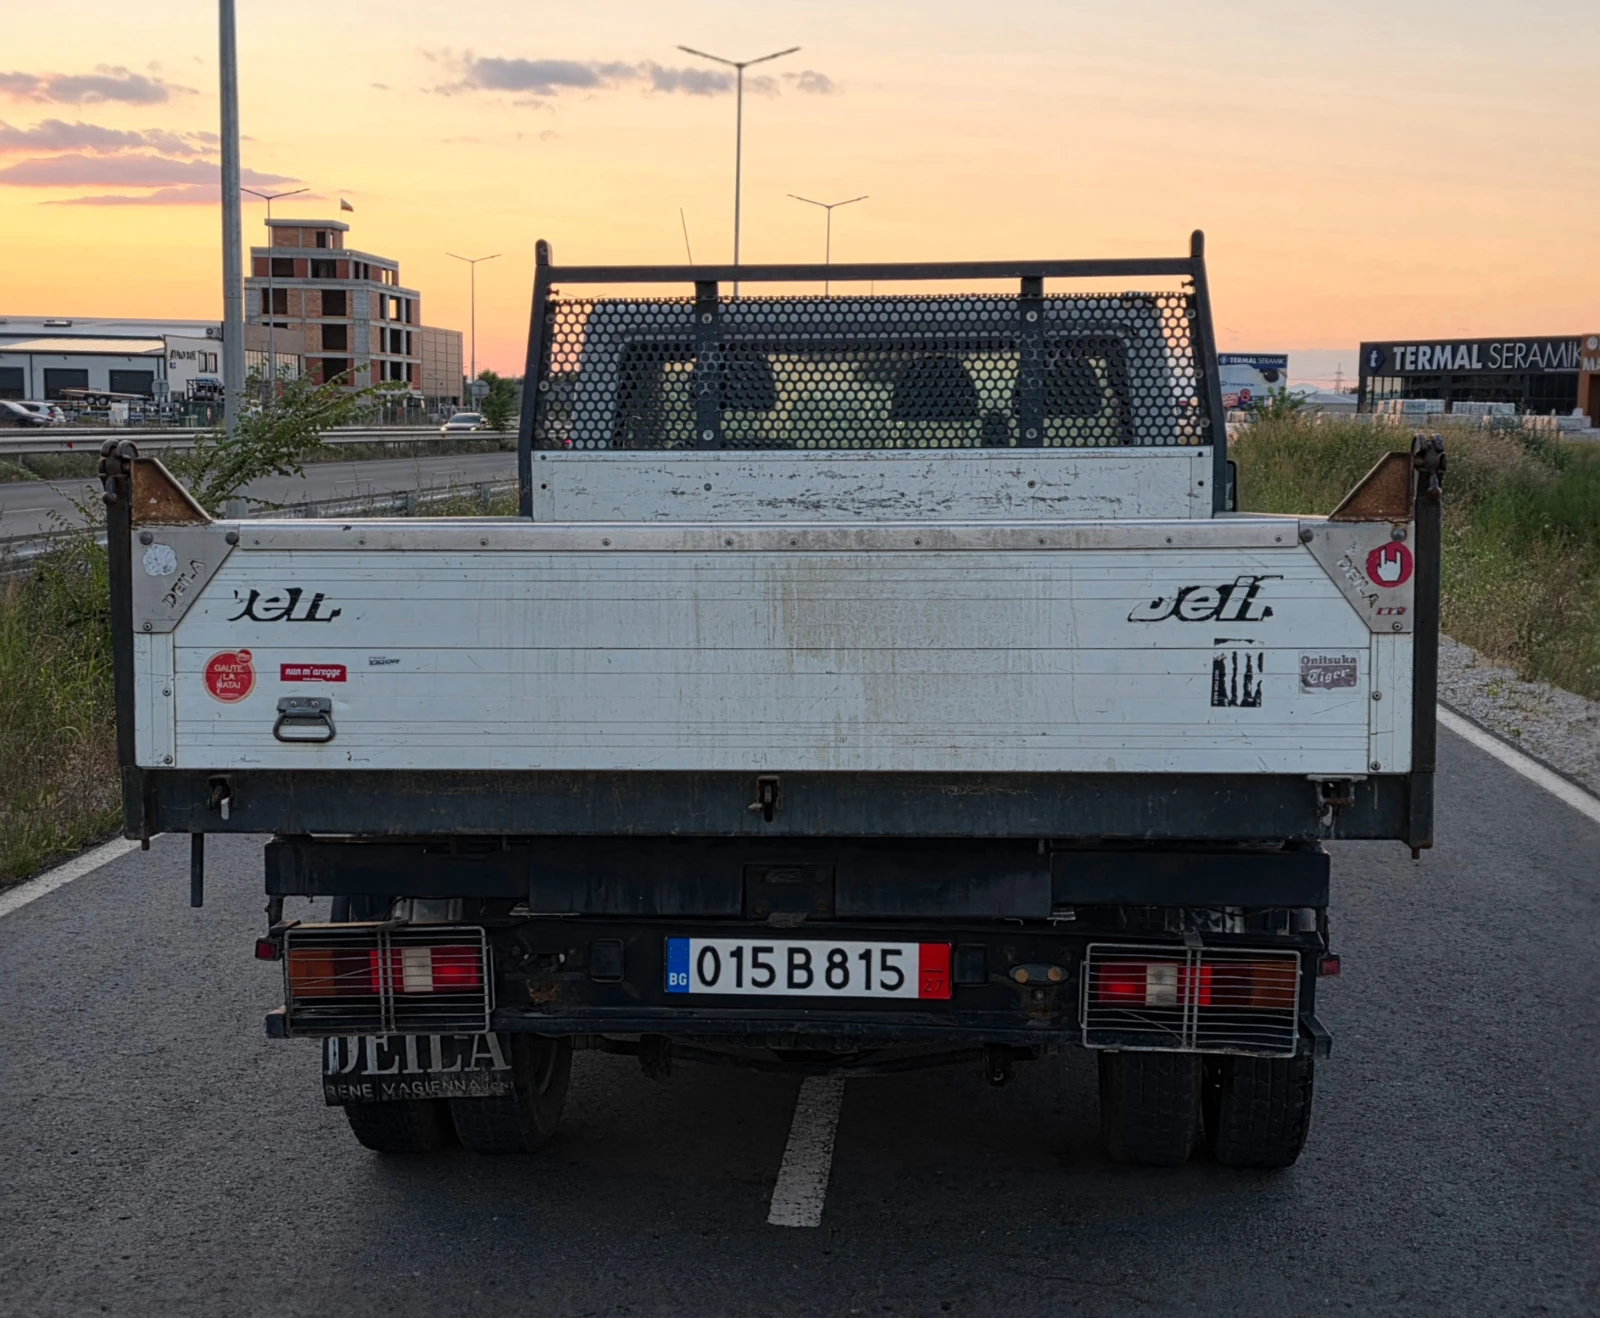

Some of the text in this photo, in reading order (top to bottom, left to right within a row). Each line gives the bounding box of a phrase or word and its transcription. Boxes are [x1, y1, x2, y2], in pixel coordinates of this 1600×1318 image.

[1229, 356, 1257, 364] TERMAL
[1392, 344, 1483, 371] TERMAL
[1301, 655, 1357, 665] Onitsuka
[1307, 668, 1350, 684] Tiger
[669, 972, 687, 986] BG
[382, 1080, 481, 1096] VAGIENNA
